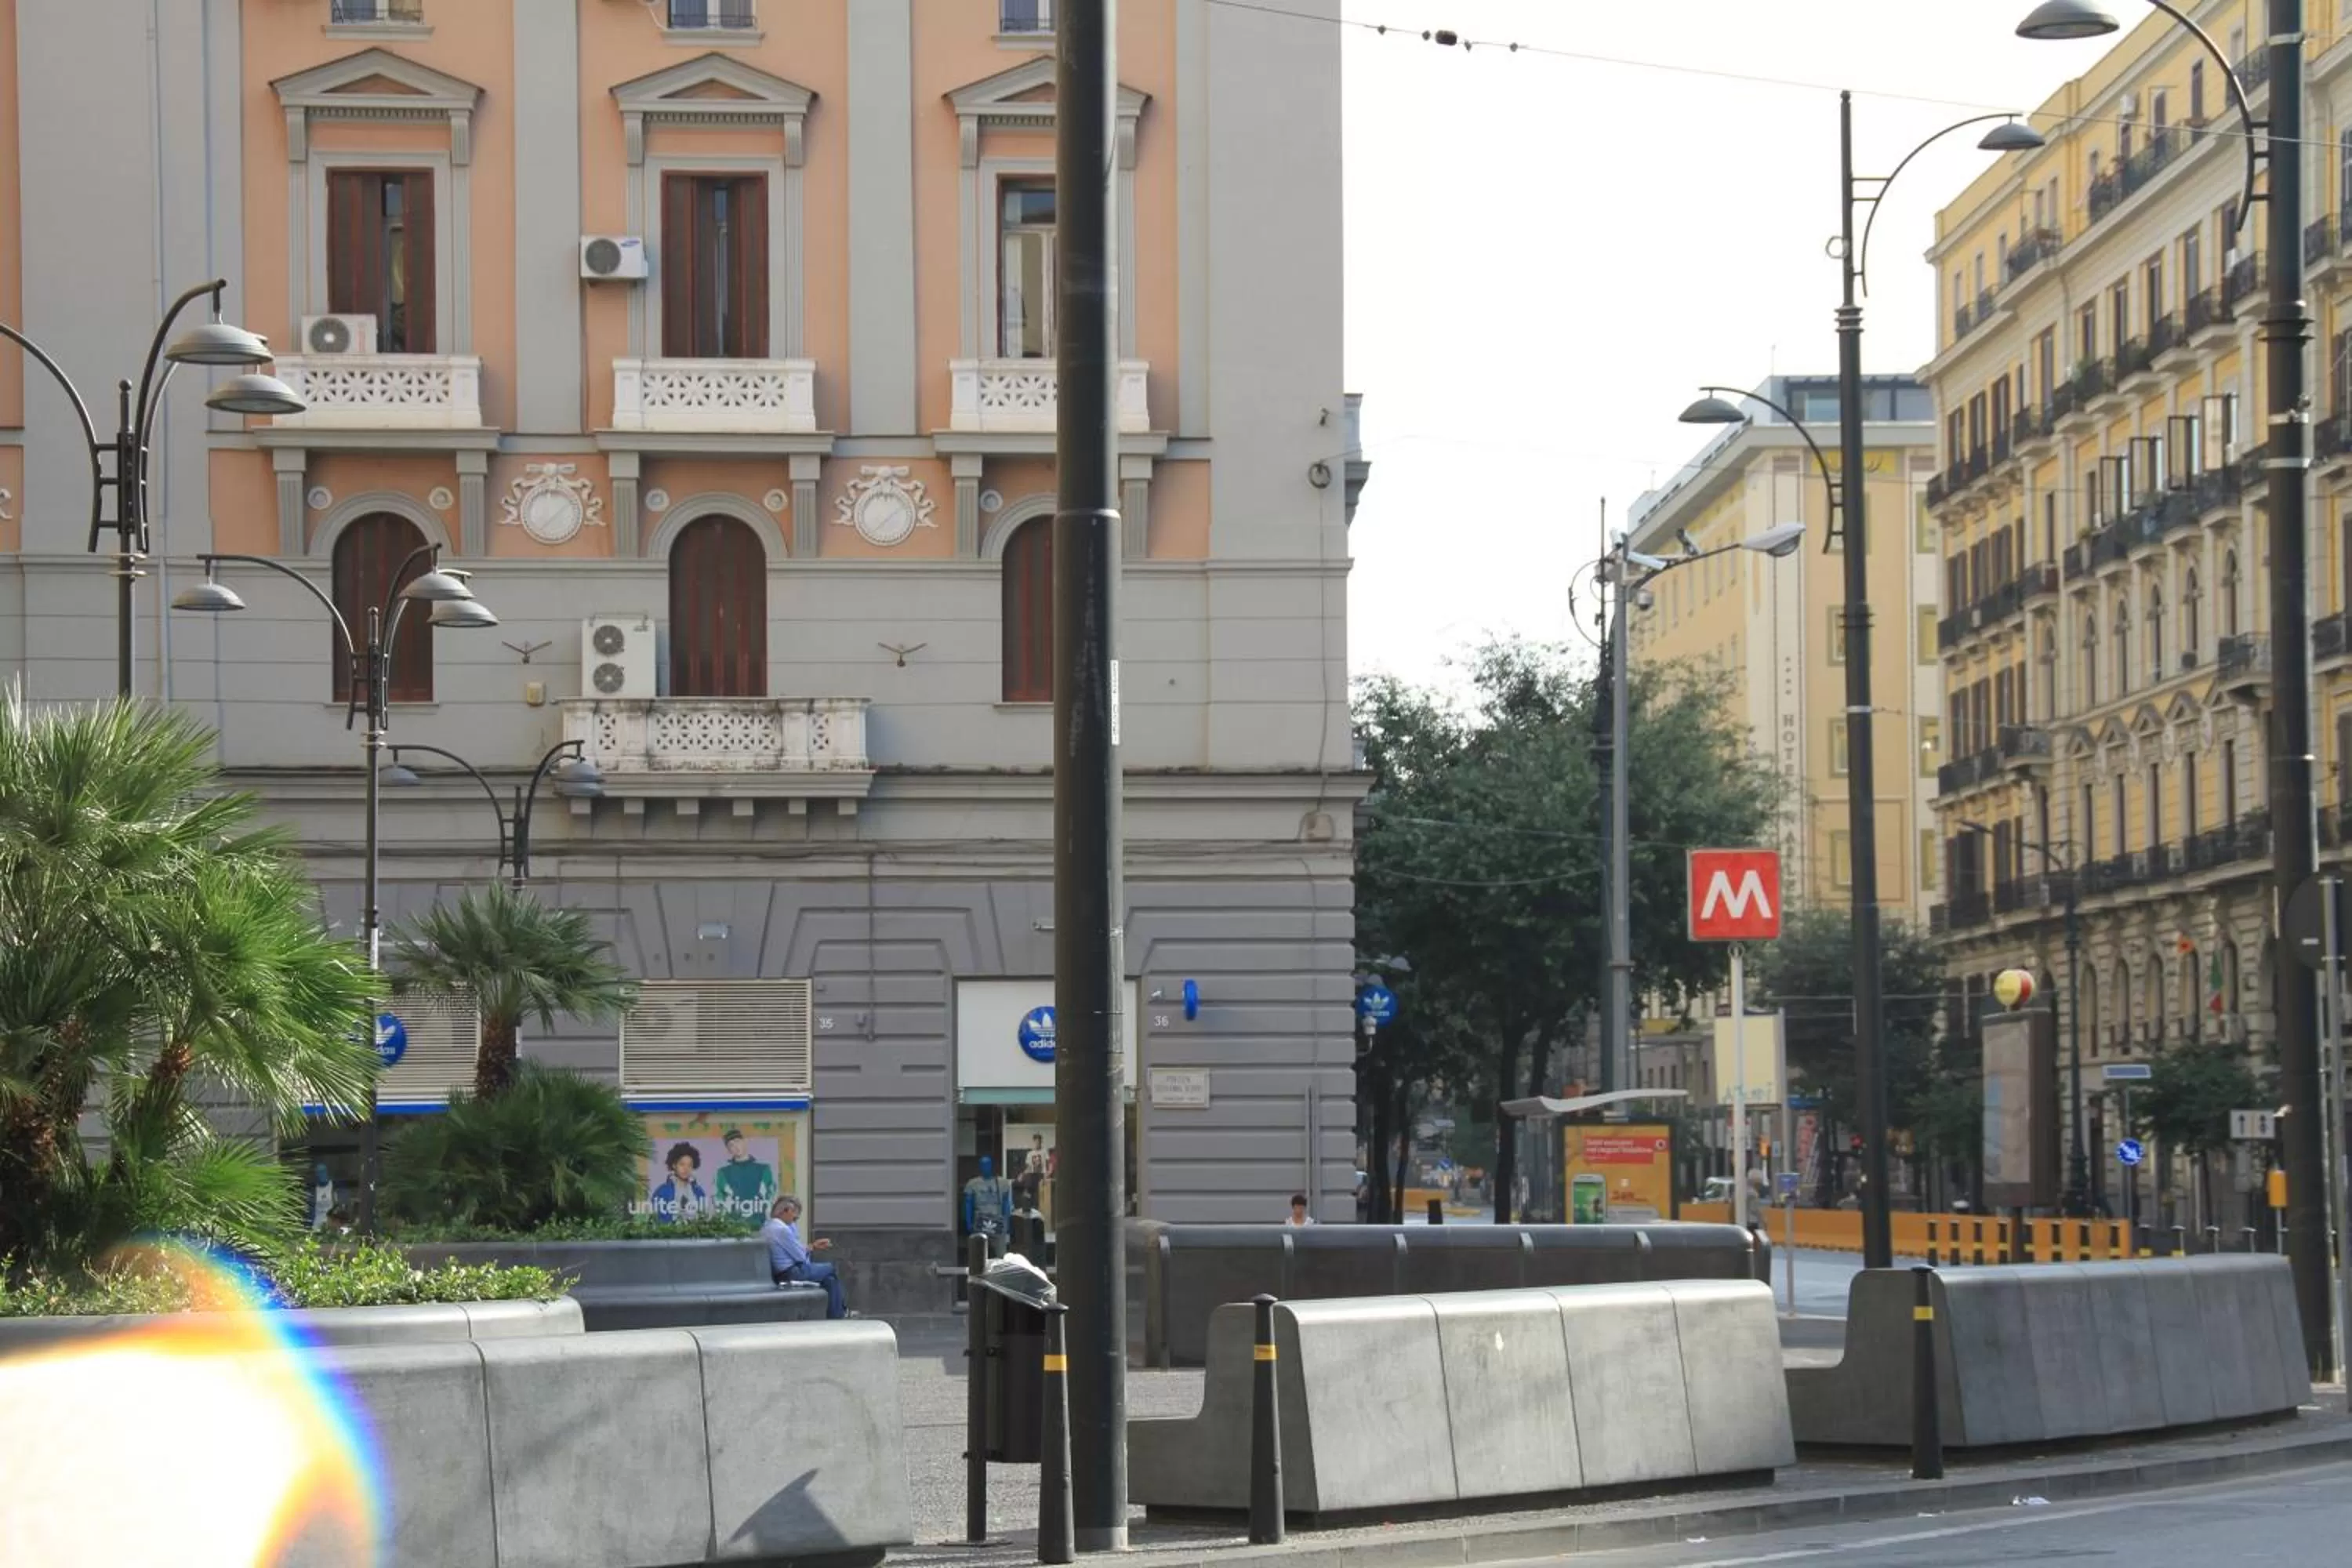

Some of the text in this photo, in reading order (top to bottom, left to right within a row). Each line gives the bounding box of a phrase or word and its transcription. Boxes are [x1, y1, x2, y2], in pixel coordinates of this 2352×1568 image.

[1782, 714, 1795, 790] HOTE
[1700, 869, 1773, 920] M
[1153, 1015, 1169, 1026] 36
[1028, 1038, 1055, 1048] adid
[628, 1196, 678, 1214] unite
